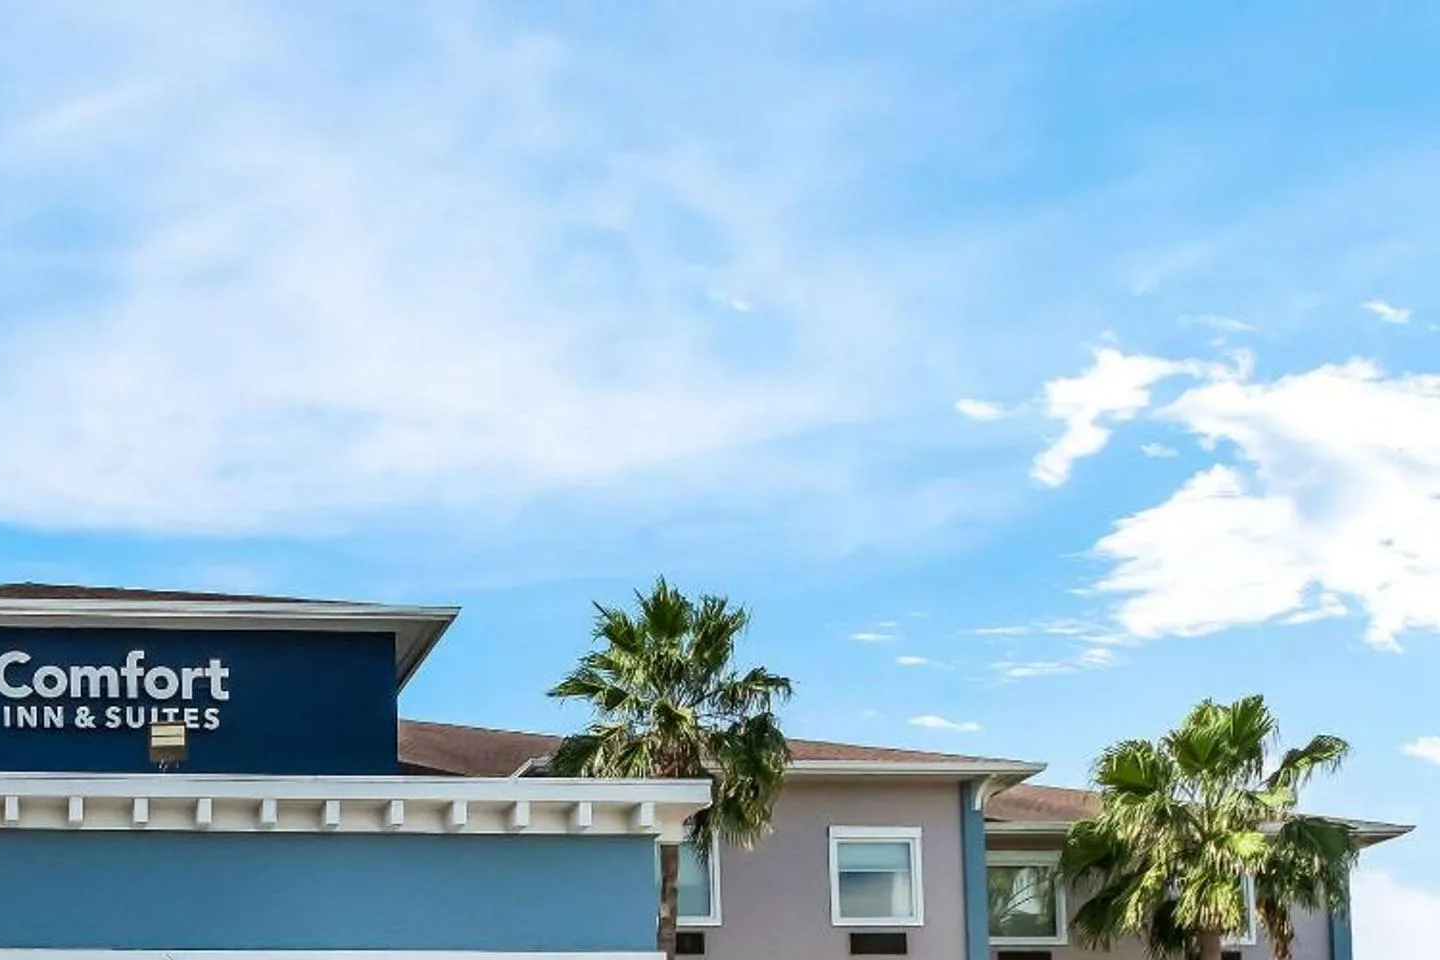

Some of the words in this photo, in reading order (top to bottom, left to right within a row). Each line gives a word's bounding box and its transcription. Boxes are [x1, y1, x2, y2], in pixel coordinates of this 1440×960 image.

[3, 706, 64, 729] INN
[75, 706, 97, 729] &
[105, 706, 220, 730] SUITES
